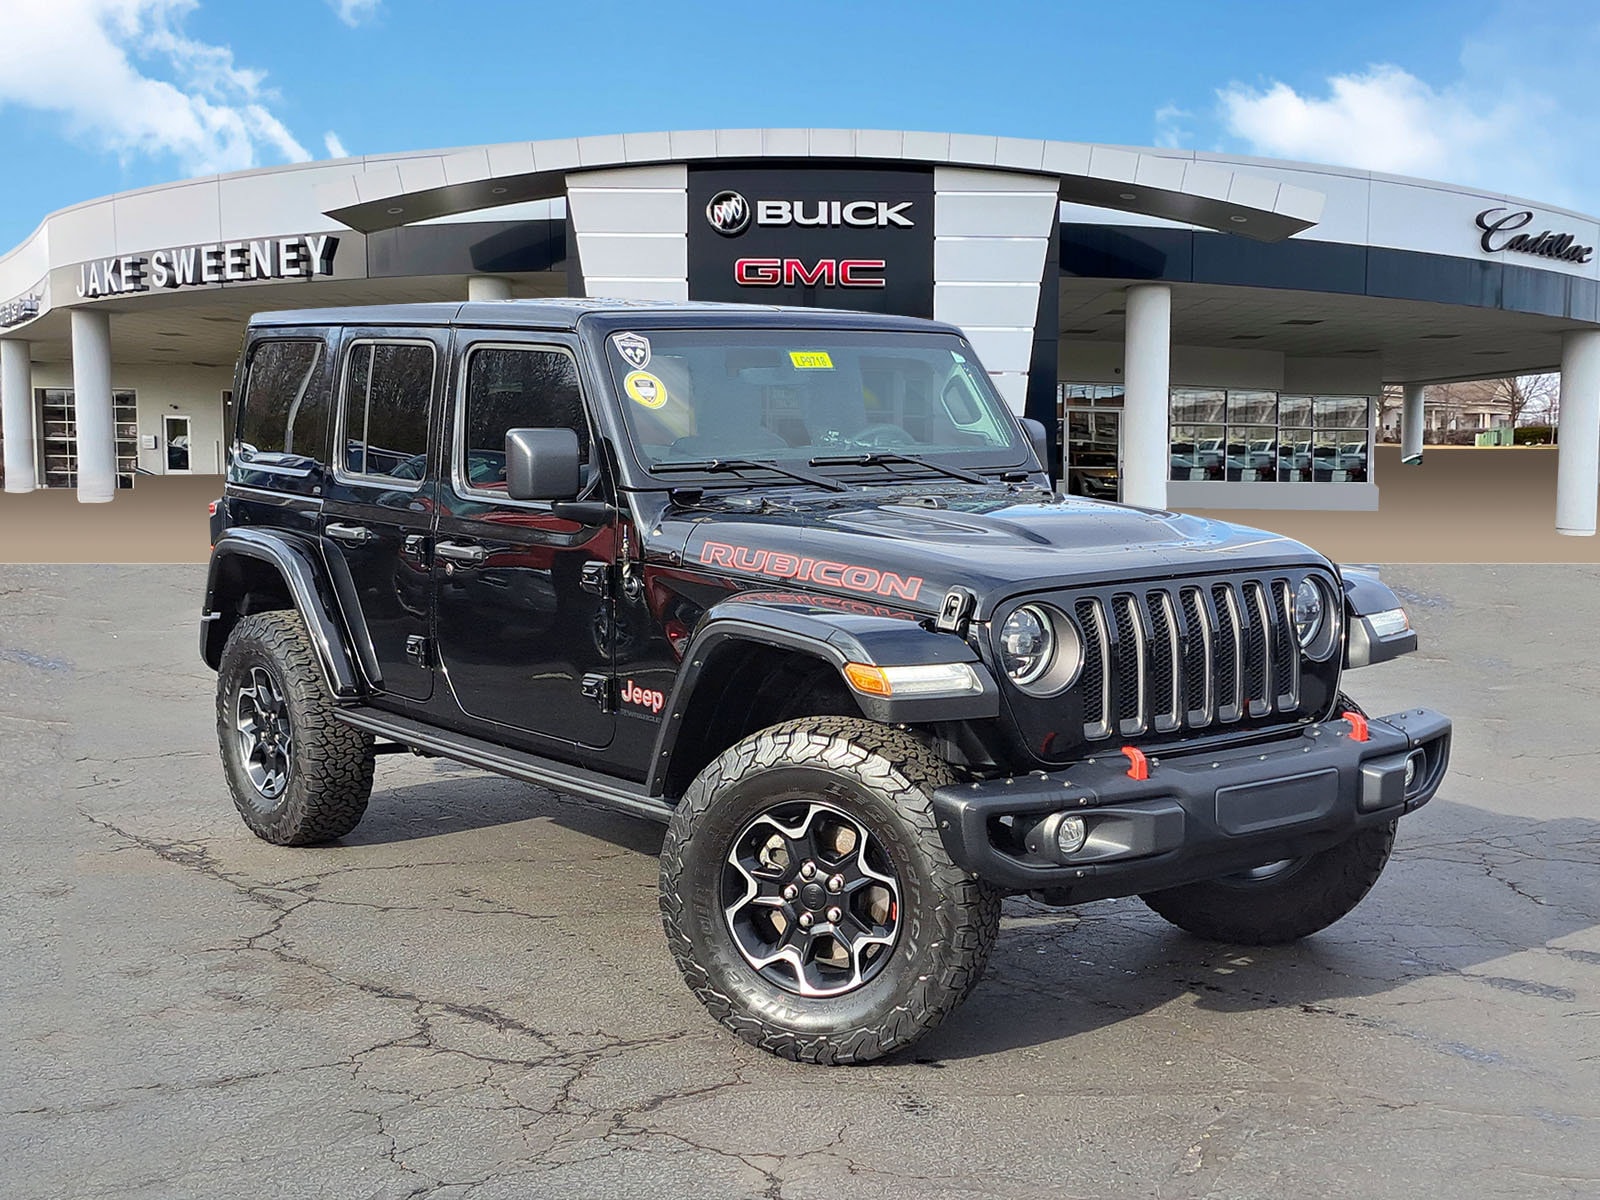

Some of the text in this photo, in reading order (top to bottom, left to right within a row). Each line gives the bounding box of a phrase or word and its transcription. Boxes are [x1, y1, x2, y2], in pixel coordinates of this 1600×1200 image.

[756, 200, 915, 226] BUICK
[1475, 207, 1593, 263] Cadillac
[76, 235, 333, 298] JAKE SWEENEY
[734, 258, 886, 287] GMC
[700, 541, 923, 601] RUBICON
[621, 679, 664, 713] Jeep
